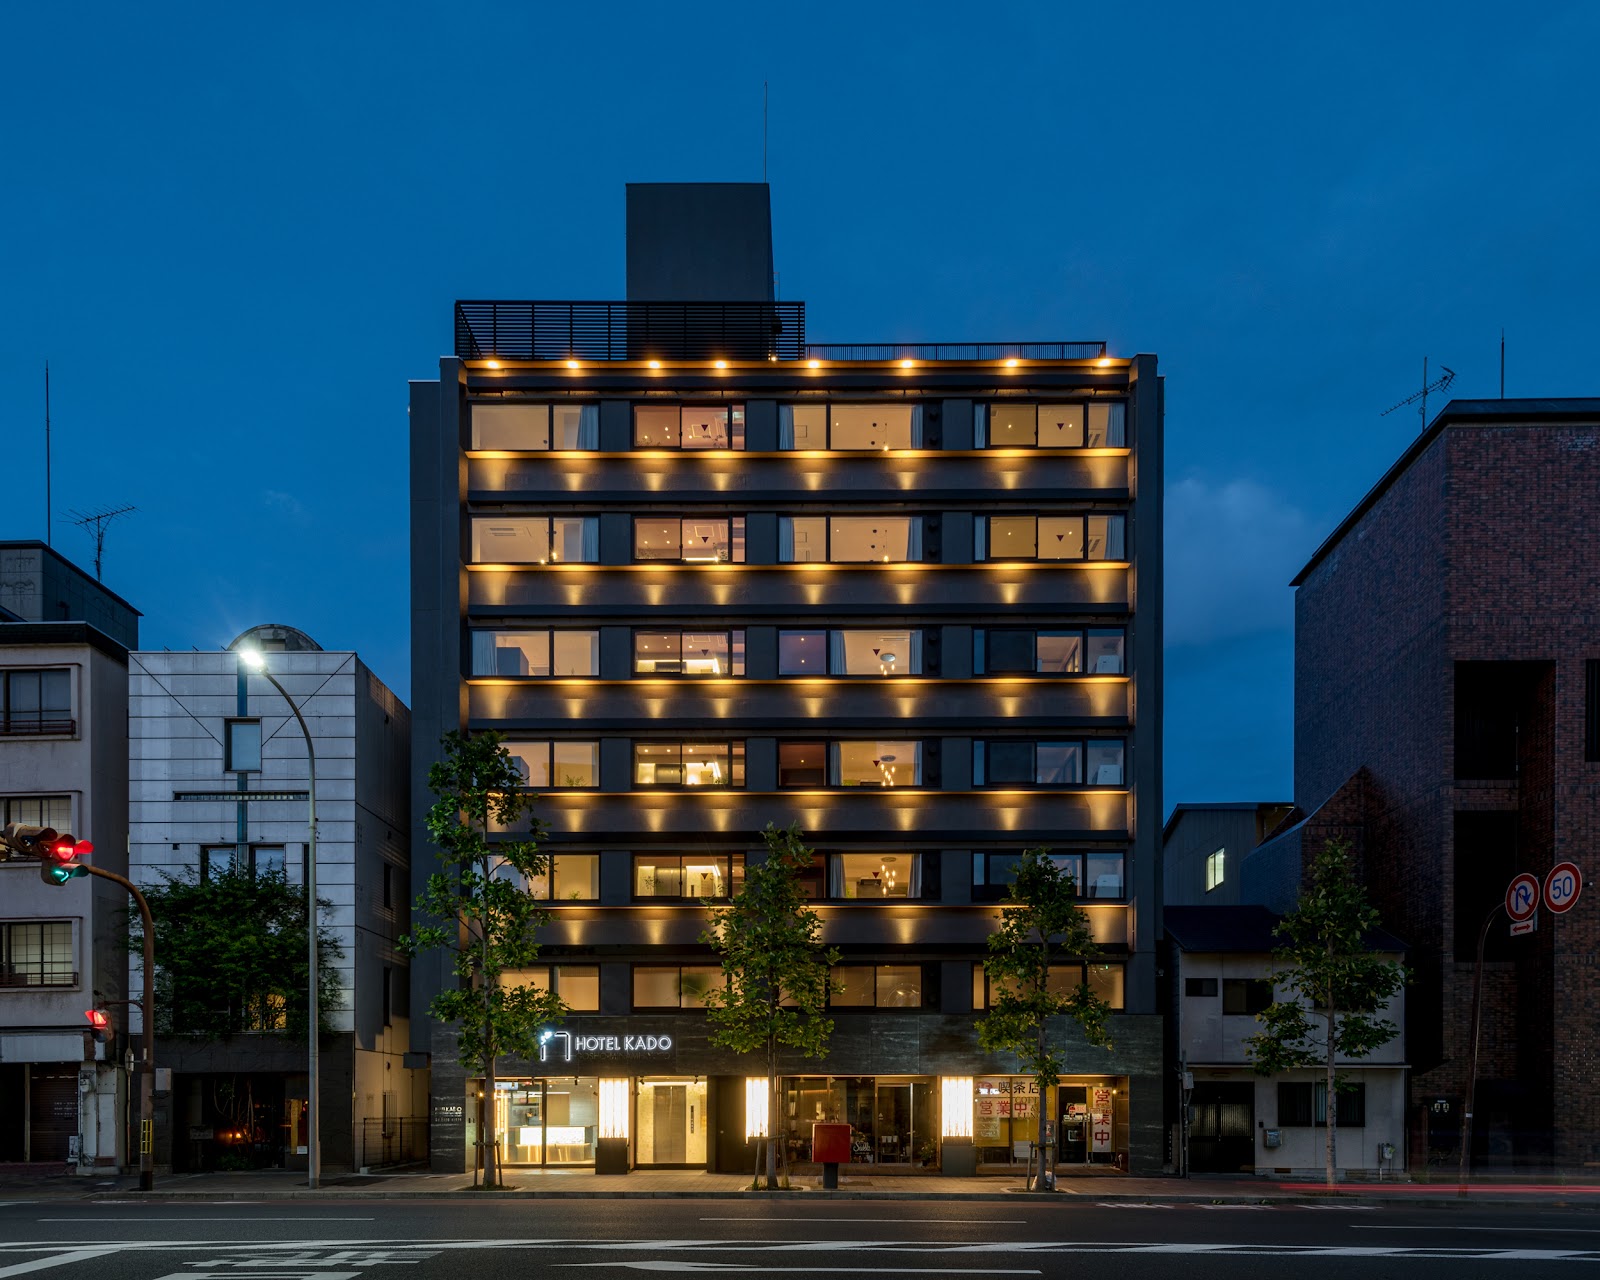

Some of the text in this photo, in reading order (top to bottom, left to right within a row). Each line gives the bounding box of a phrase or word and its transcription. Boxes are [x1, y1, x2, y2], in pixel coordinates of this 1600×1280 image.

[1552, 876, 1573, 900] 50
[574, 1035, 673, 1051] HOTEL KADO
[979, 1100, 1028, 1116] 営業中
